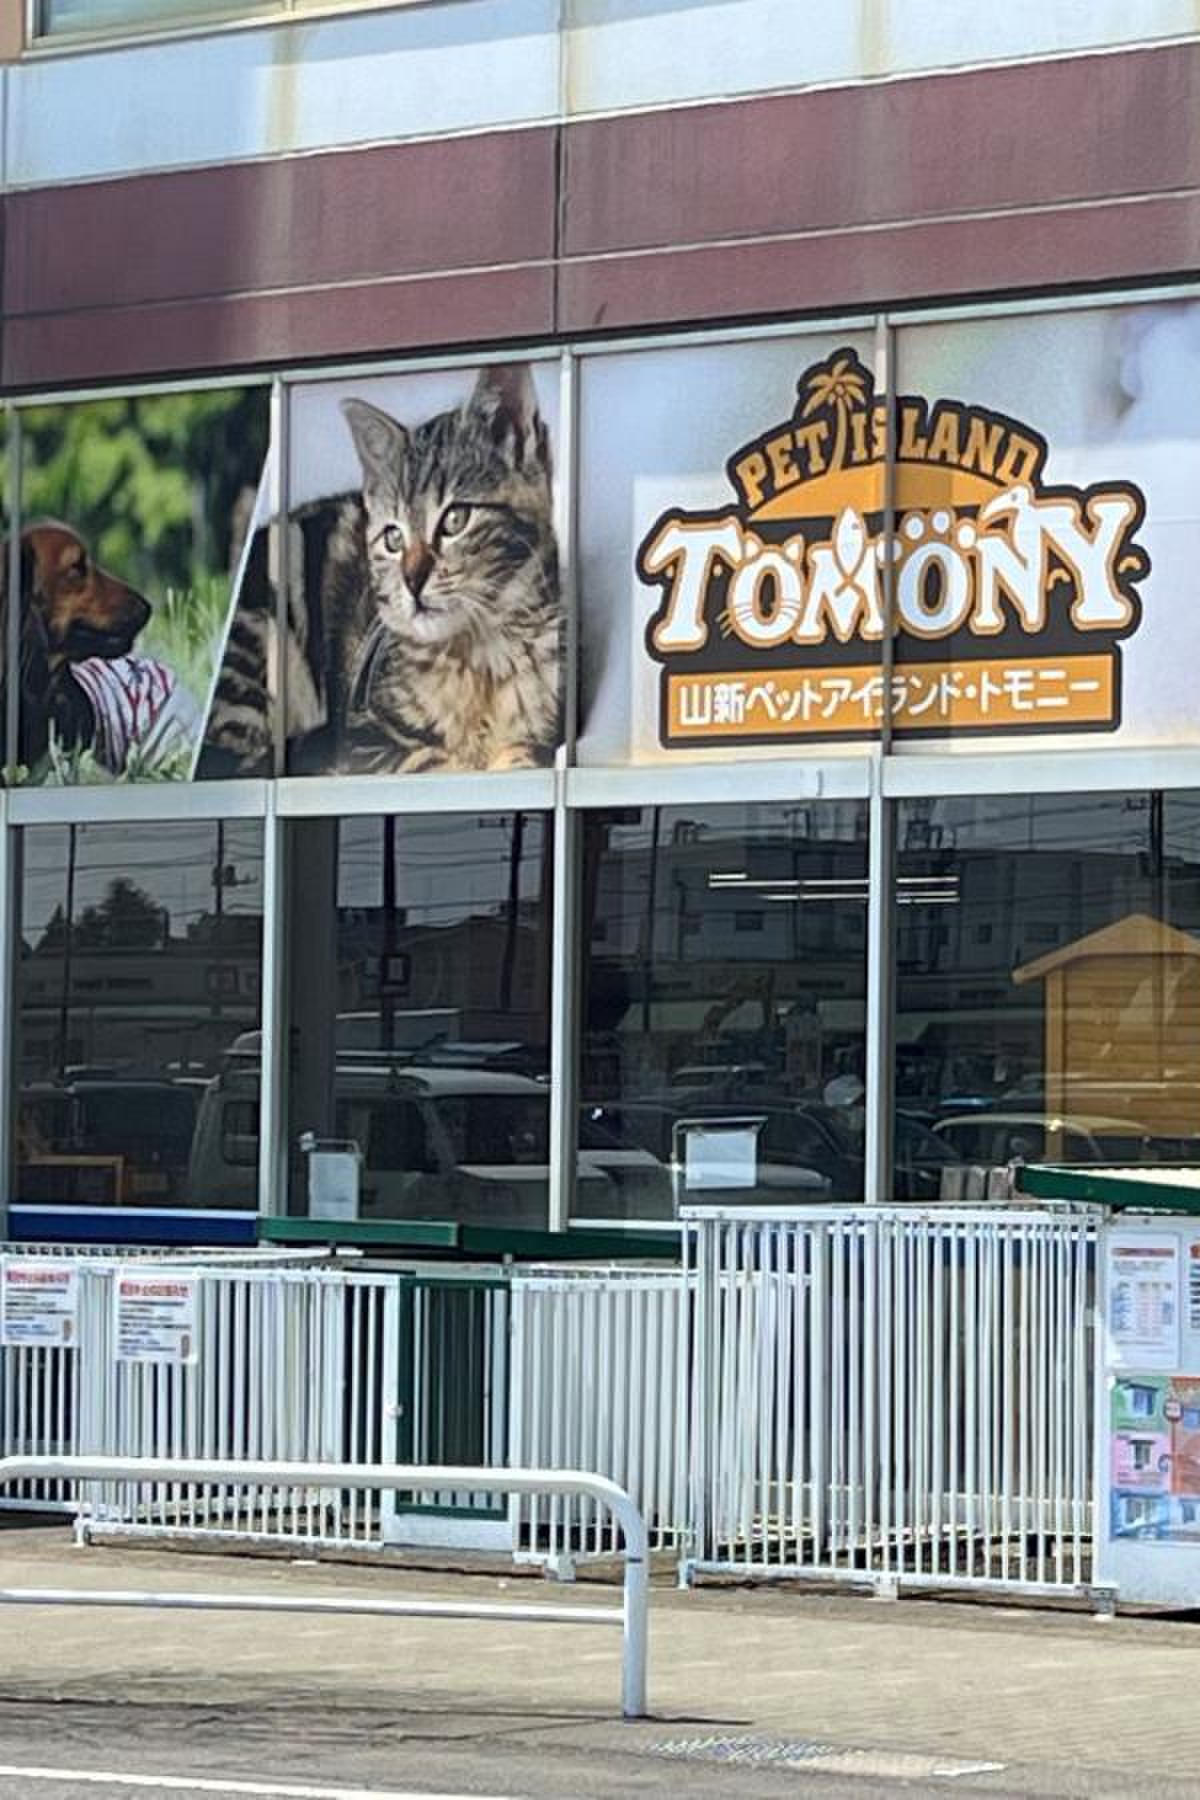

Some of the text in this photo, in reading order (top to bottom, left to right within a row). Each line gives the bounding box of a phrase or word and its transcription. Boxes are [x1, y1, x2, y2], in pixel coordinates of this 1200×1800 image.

[735, 404, 1041, 509] PET ISLAND
[642, 484, 1138, 652] TOMONY
[679, 668, 1100, 726] 山新ペットアイランド・トモニー
